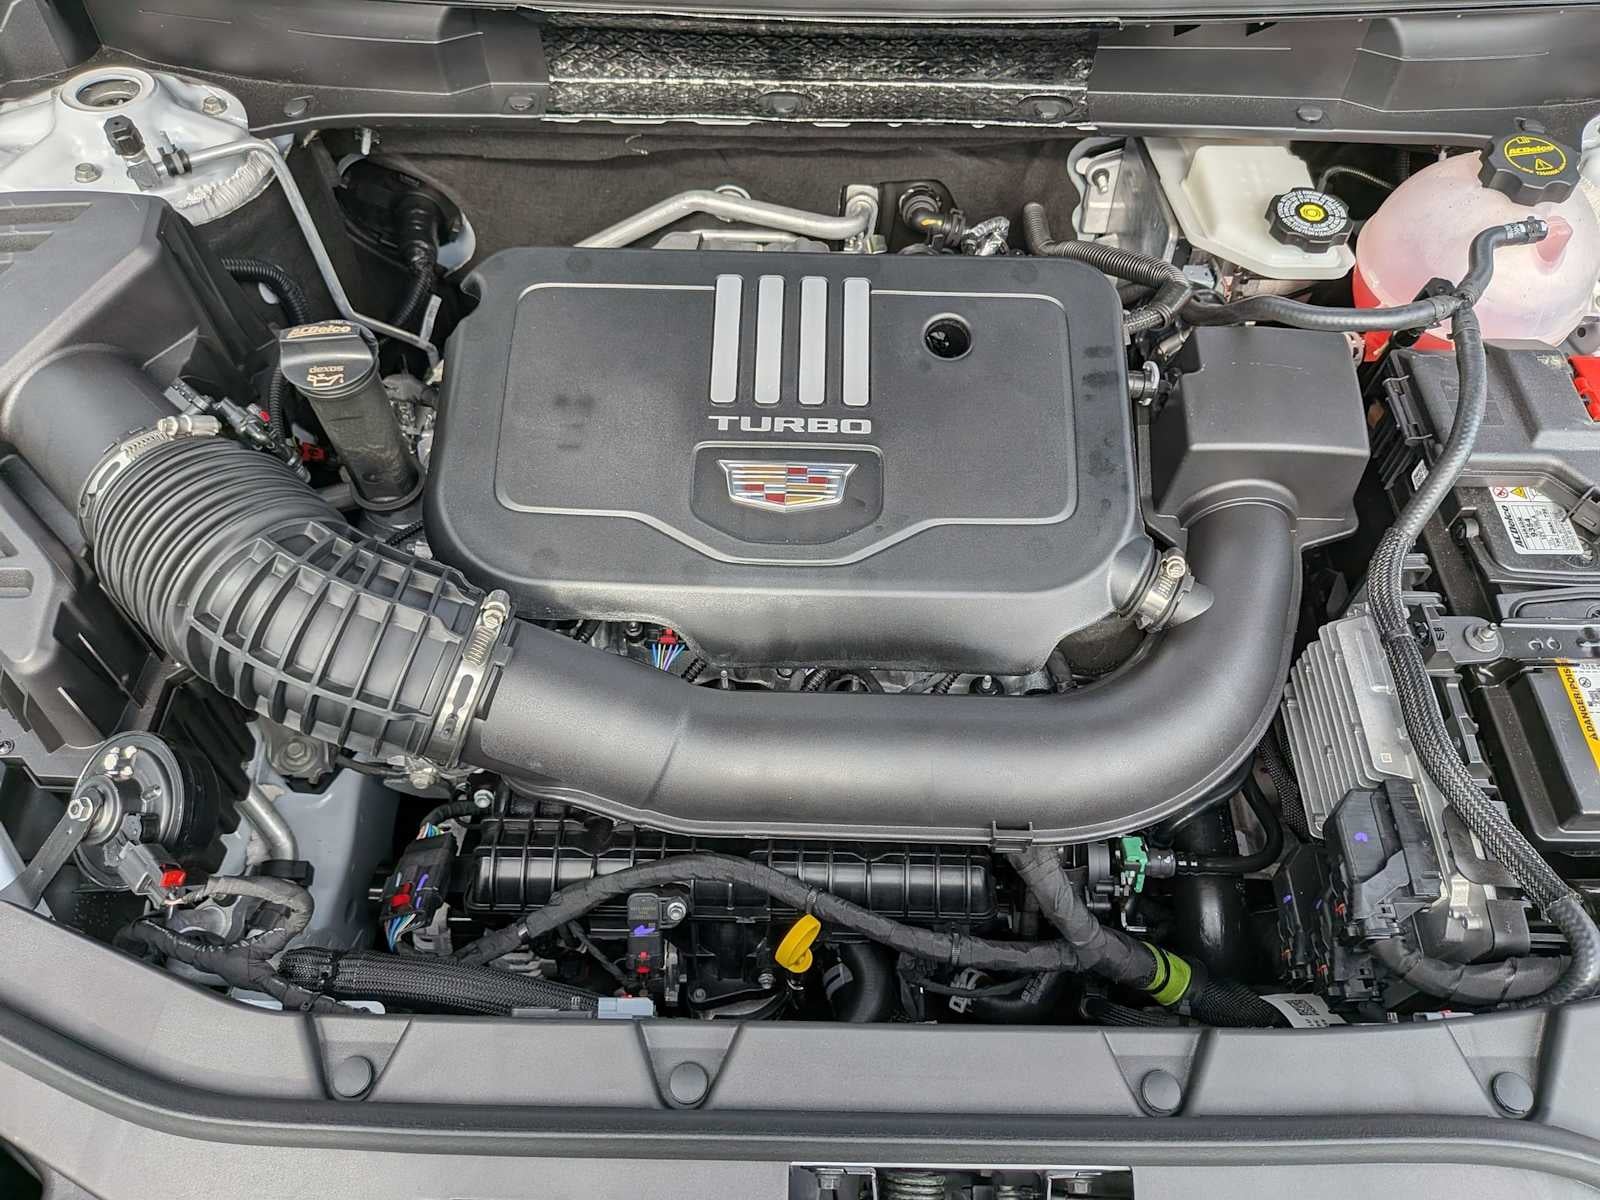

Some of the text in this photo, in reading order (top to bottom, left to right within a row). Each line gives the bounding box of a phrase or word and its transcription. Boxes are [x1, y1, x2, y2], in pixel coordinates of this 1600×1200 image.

[1509, 145, 1555, 157] ACDelco
[286, 325, 352, 338] ACDelco
[308, 365, 345, 374] dexos
[708, 415, 872, 434] TURBO
[1501, 504, 1525, 548] ACDelco
